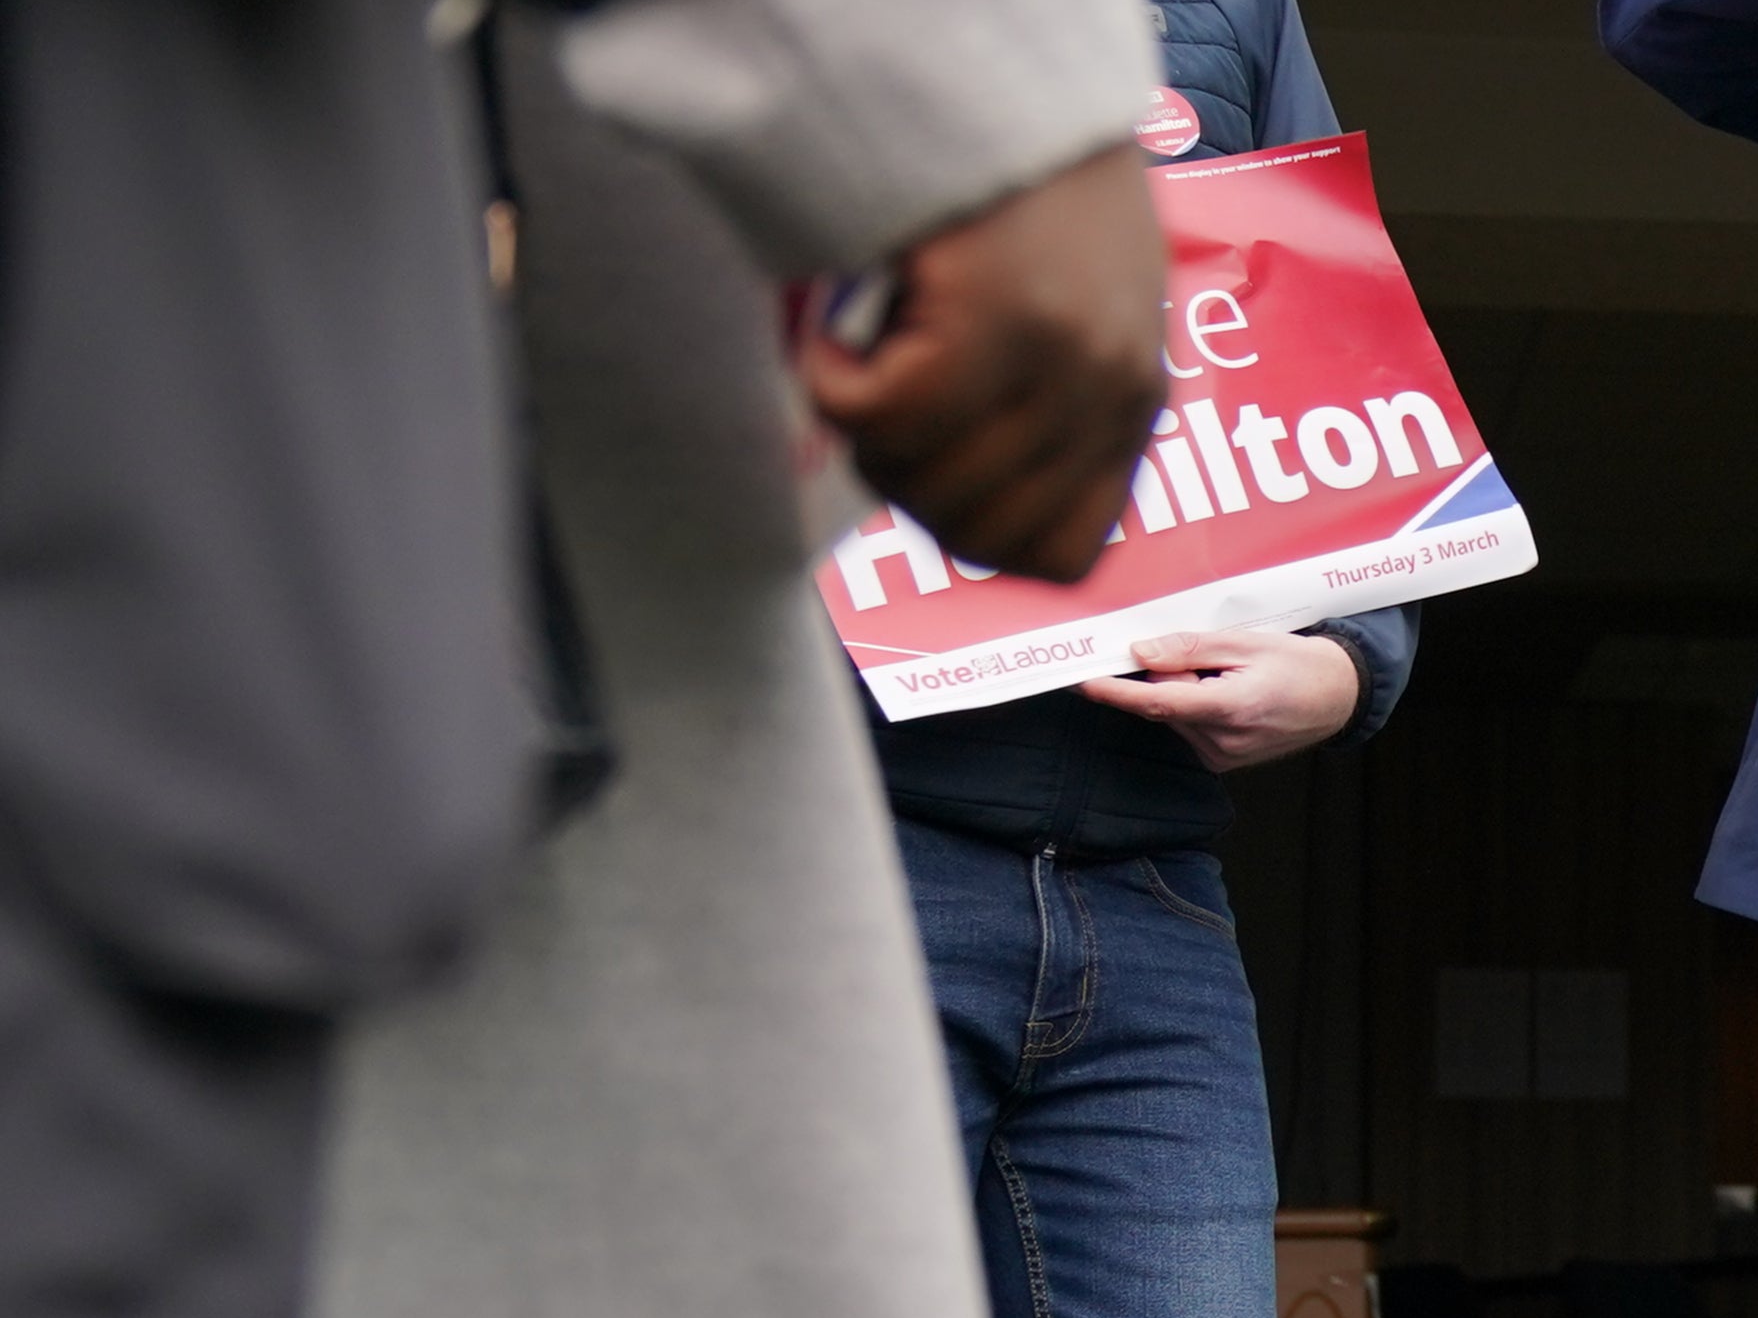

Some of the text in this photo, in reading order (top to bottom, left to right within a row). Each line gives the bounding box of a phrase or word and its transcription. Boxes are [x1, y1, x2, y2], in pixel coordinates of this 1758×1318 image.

[833, 390, 1463, 612] Hilton
[1322, 531, 1500, 589] Thursday 3 March
[895, 664, 974, 694] Vote
[994, 635, 1096, 673] Labour
